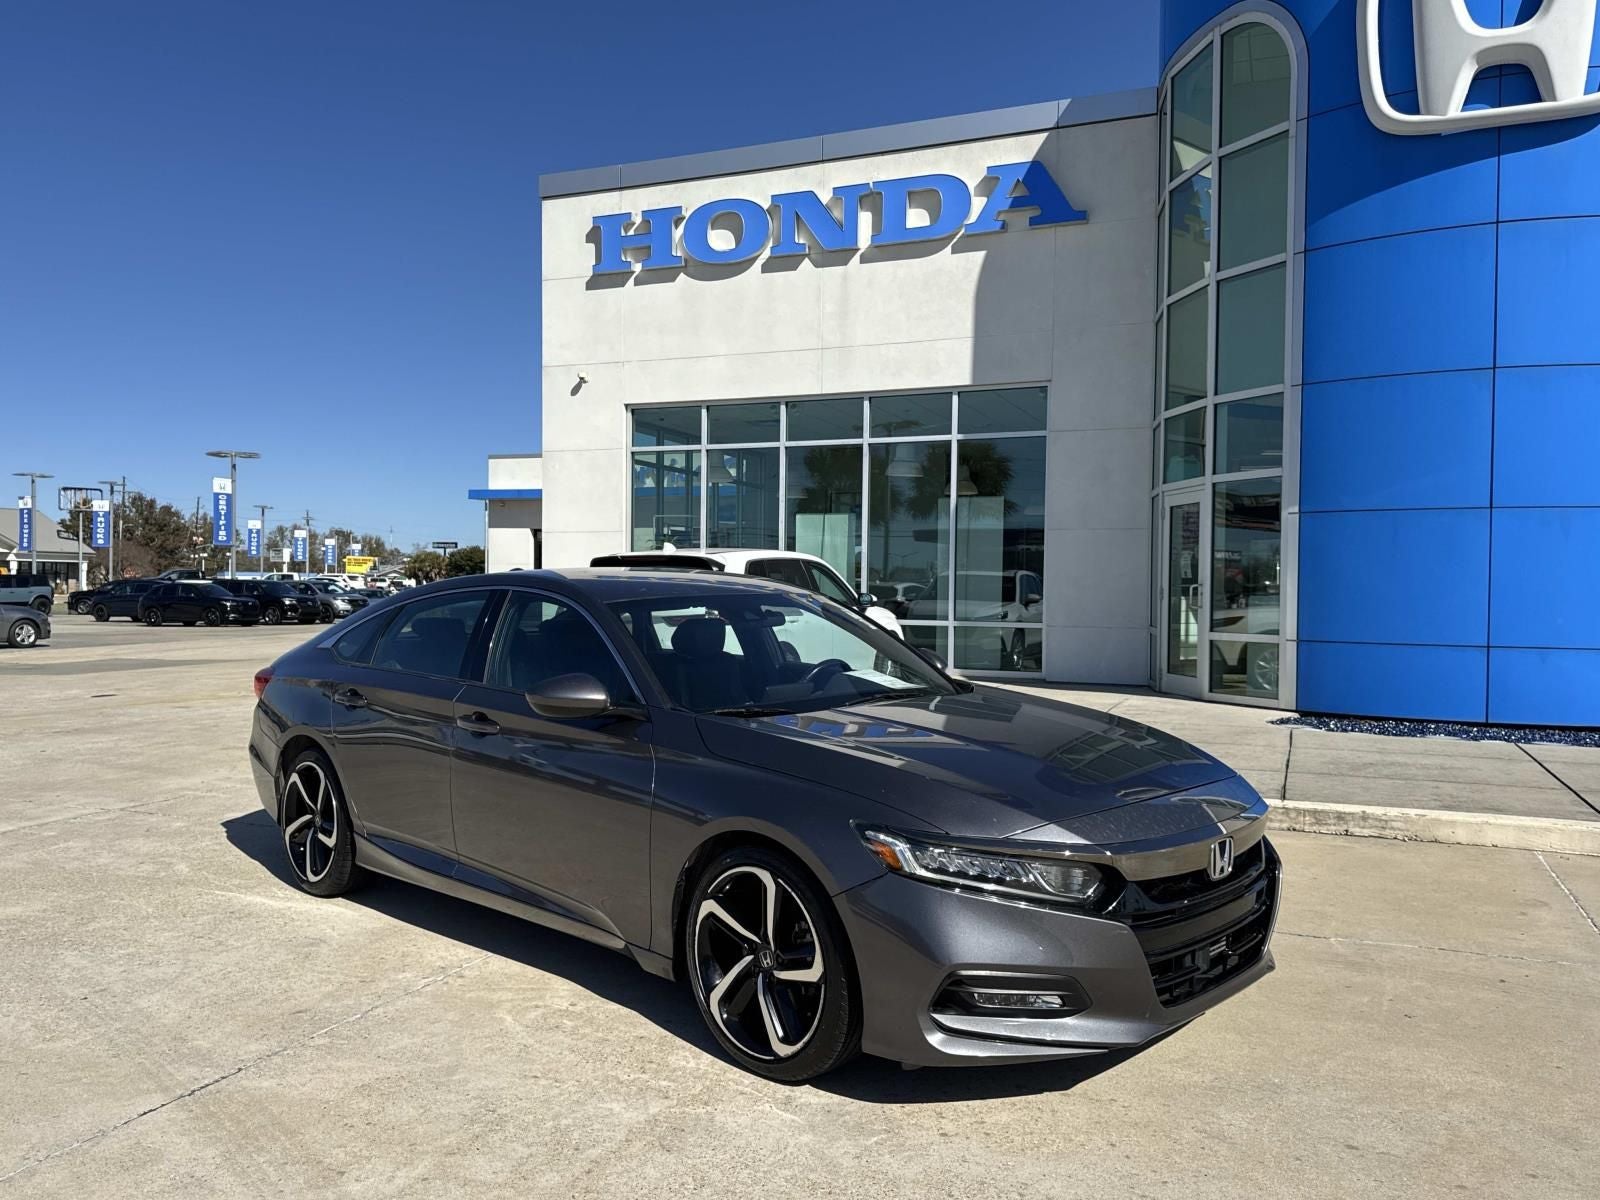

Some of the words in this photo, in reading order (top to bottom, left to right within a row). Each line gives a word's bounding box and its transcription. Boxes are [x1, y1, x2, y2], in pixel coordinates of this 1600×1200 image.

[592, 160, 1088, 275] HONDA
[97, 511, 105, 545] TRUCKS
[218, 494, 227, 541] CERTIFIED
